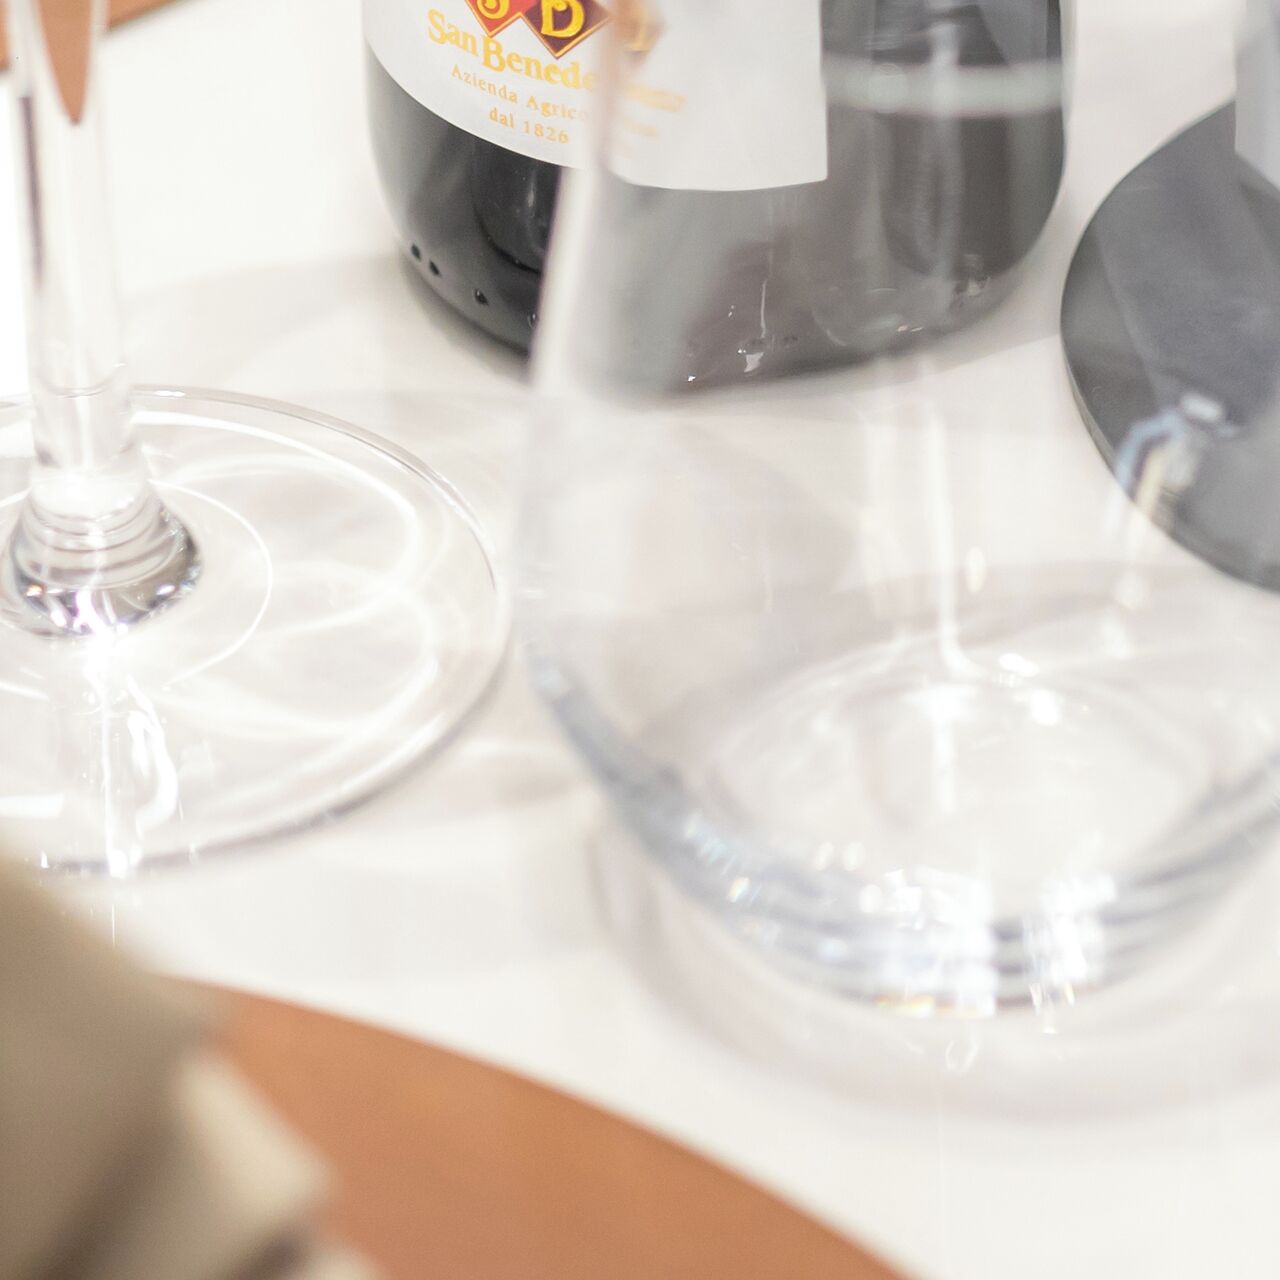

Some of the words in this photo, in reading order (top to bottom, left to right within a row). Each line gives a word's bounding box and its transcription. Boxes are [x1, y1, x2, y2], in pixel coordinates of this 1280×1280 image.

[427, 8, 479, 57] San
[451, 63, 519, 104] Azienda
[488, 106, 516, 129] dal
[523, 120, 570, 144] 1826
